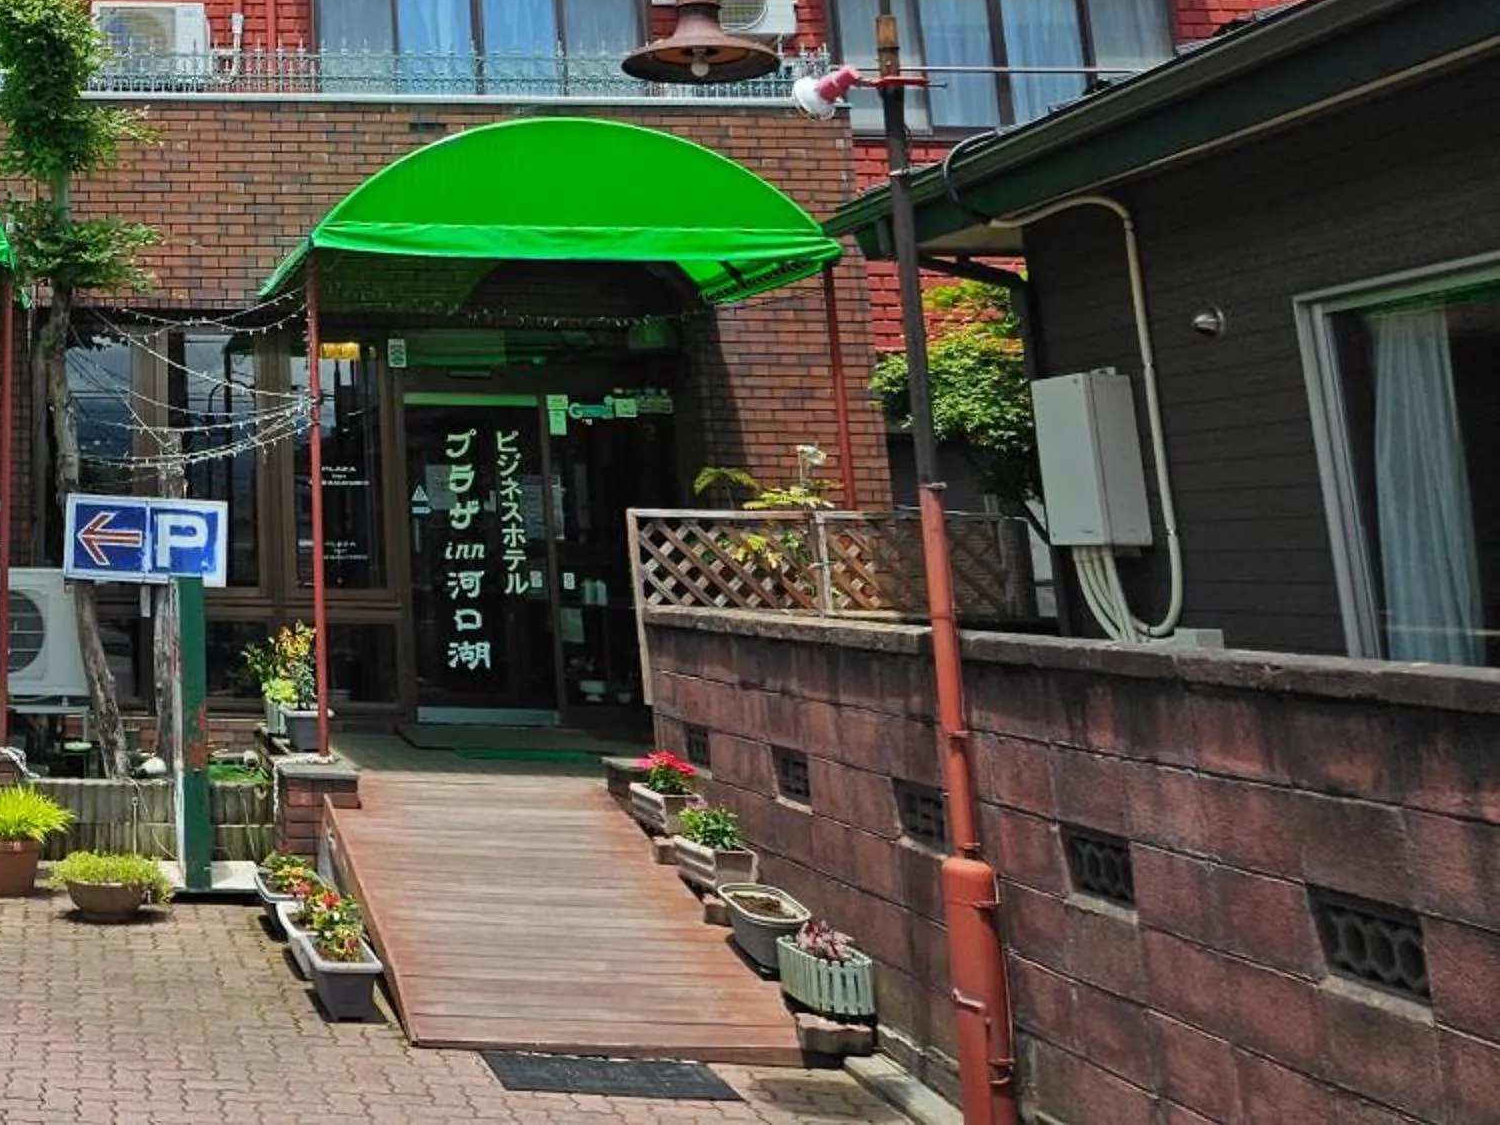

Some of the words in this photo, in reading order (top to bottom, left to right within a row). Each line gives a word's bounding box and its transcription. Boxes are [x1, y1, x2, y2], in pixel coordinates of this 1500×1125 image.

[156, 512, 209, 569] P
[496, 430, 529, 596] ビジネスホテル
